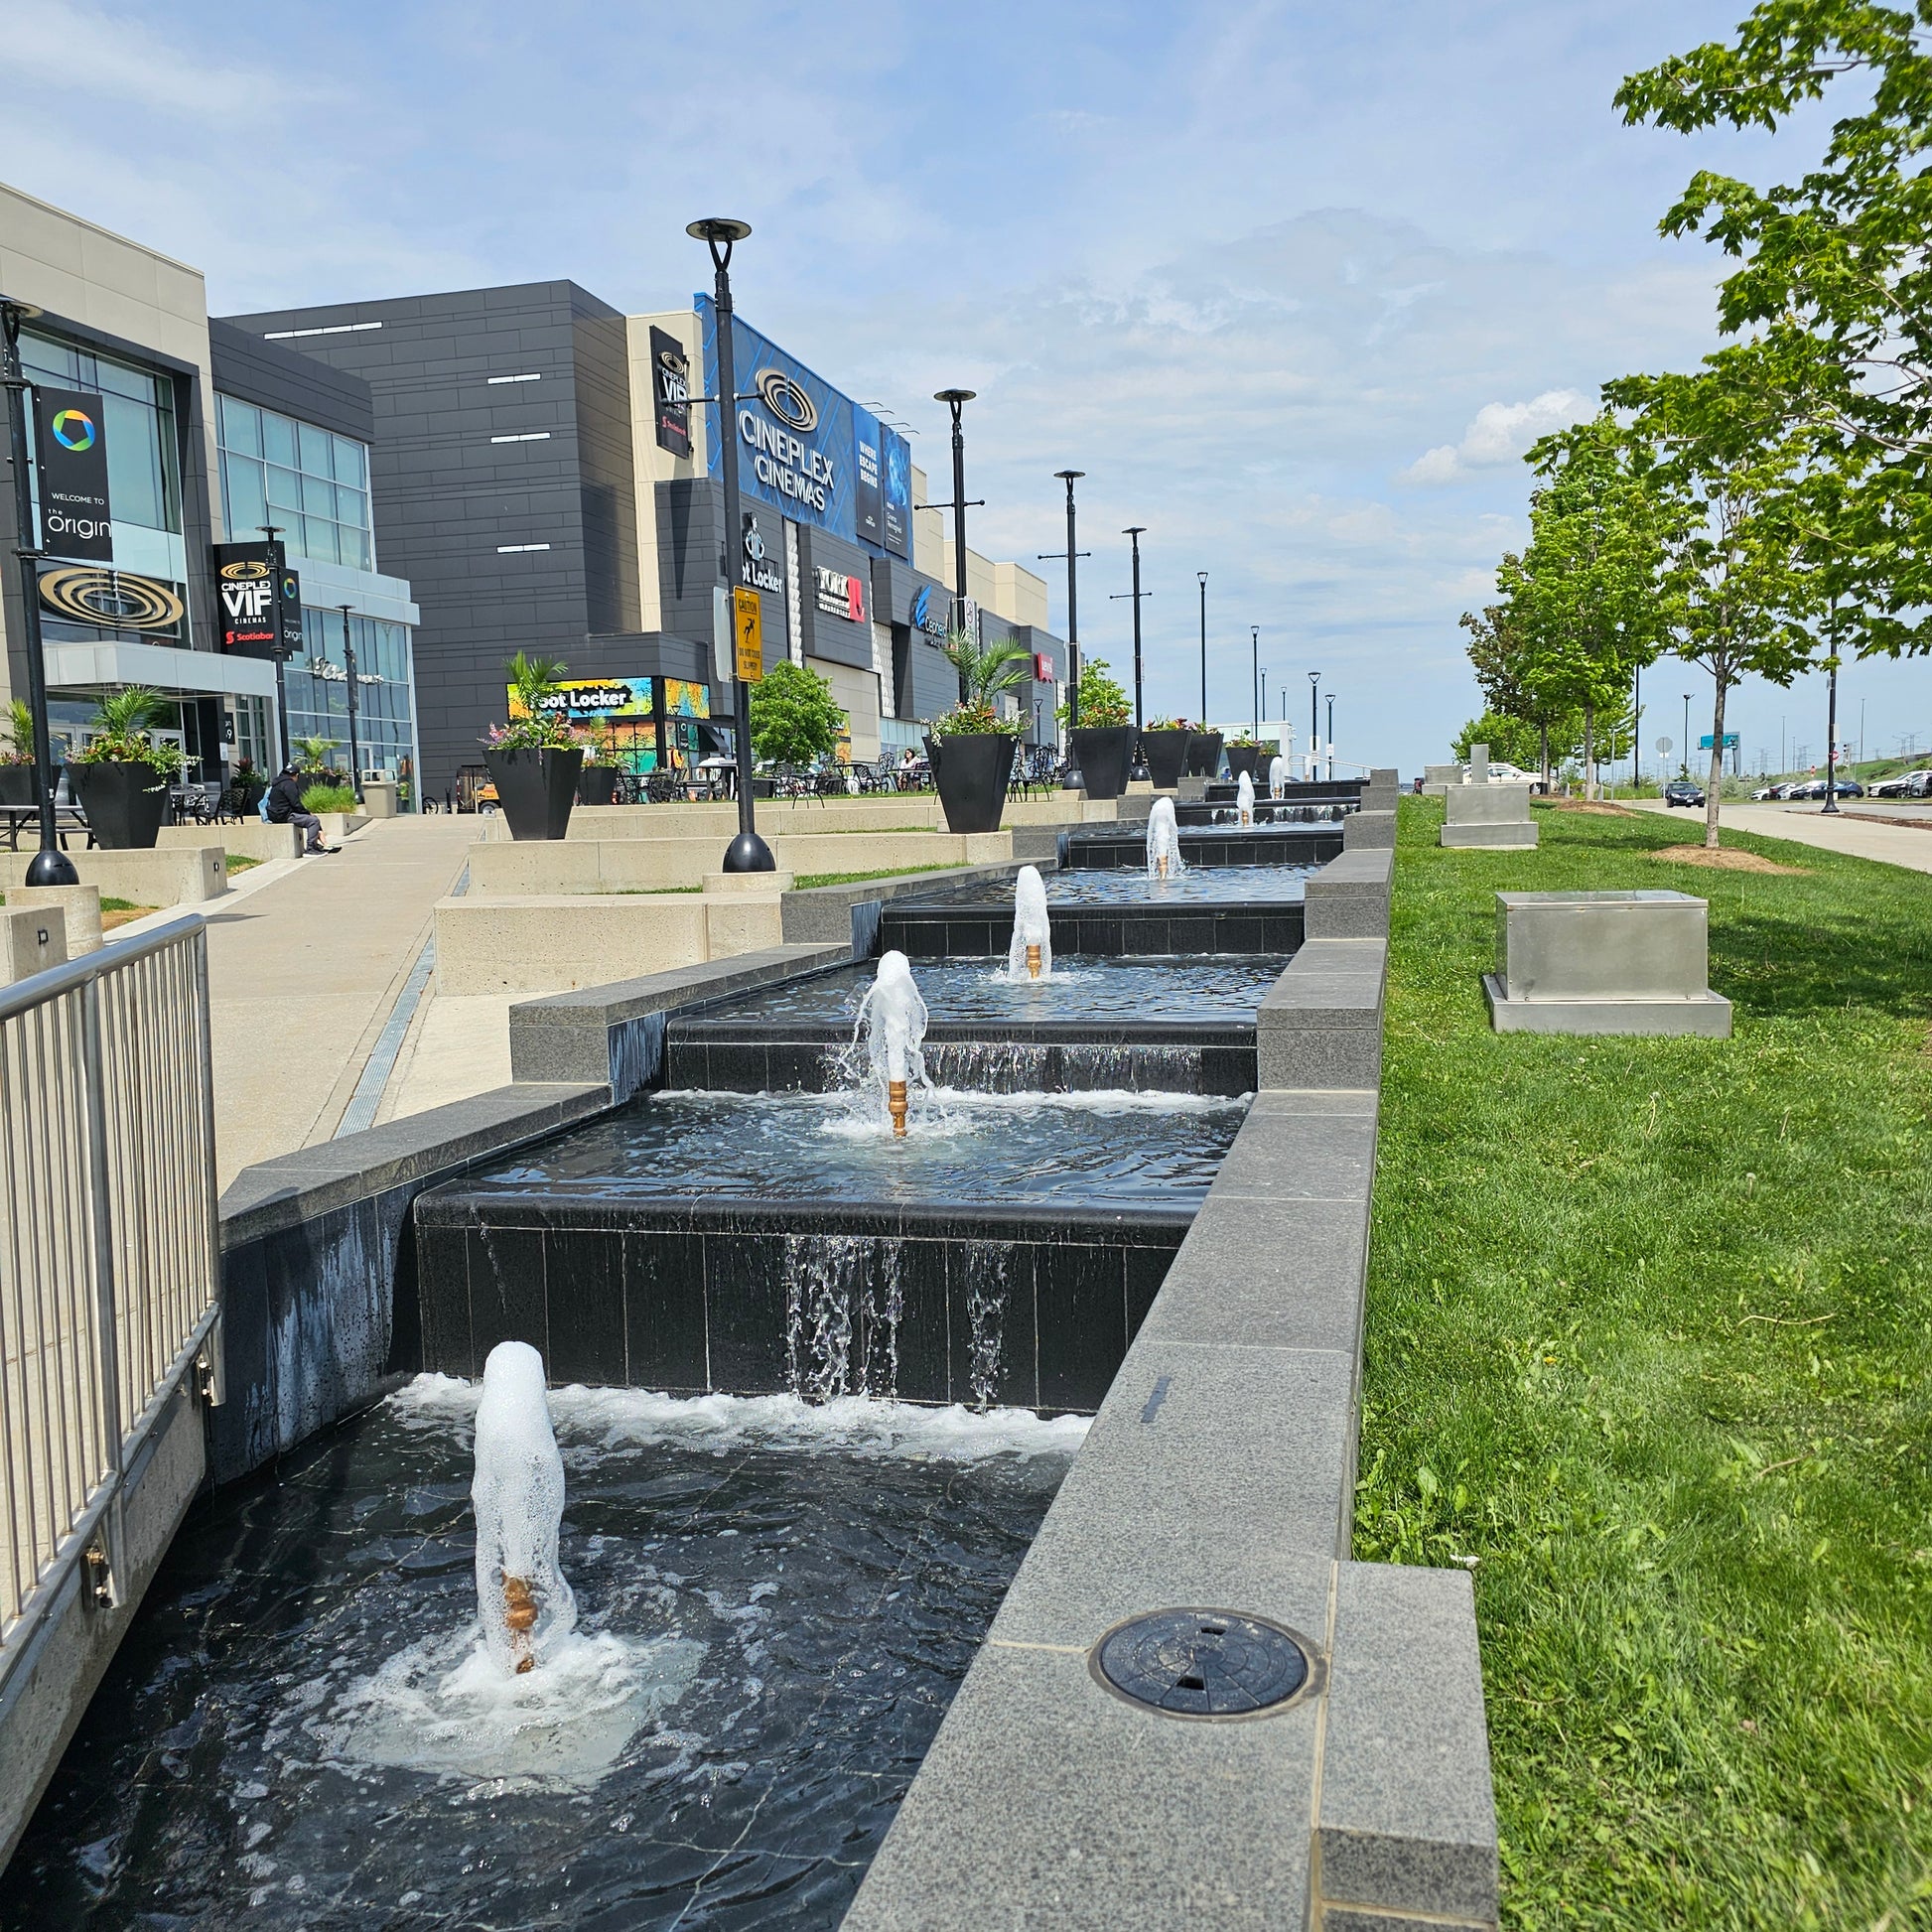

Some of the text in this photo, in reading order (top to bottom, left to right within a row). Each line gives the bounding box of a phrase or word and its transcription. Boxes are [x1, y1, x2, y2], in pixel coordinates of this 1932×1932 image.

[662, 375, 688, 403] VIP
[739, 409, 834, 489] CINEPLEX
[859, 440, 877, 462] WHERE
[859, 454, 878, 476] ESCAPE
[755, 454, 825, 511] CINEMAS
[860, 469, 878, 488] BEGINS
[51, 491, 92, 504] WELCOME
[752, 562, 783, 594] Locker
[738, 598, 758, 614] CAUTION
[529, 689, 627, 710] oot Locker
